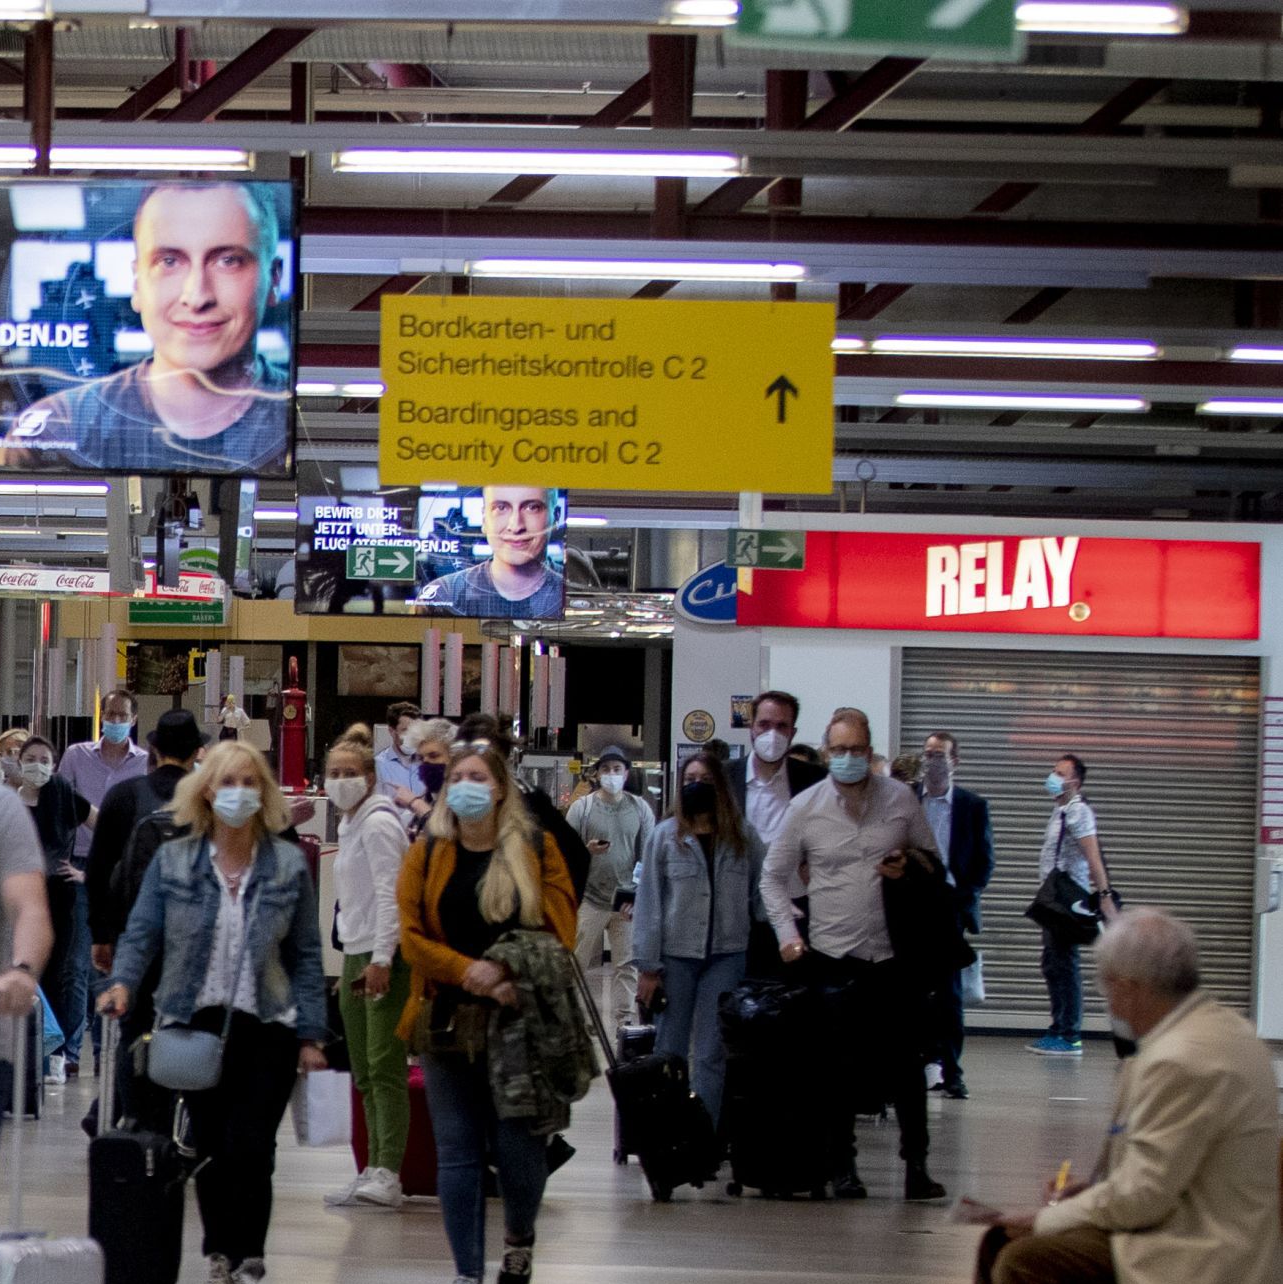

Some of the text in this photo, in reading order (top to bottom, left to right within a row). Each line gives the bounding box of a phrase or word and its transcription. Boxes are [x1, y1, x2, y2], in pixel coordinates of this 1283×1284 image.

[399, 315, 615, 341] Bordkarten- und
[398, 351, 706, 379] Sicherheitskontrolle C 2
[398, 401, 637, 431] Boardingpass and
[397, 438, 662, 466] Security Control C 2
[315, 506, 398, 520] BEWIRB DICH
[314, 522, 401, 536] JETZT UNTER:
[925, 536, 1080, 617] RELAY
